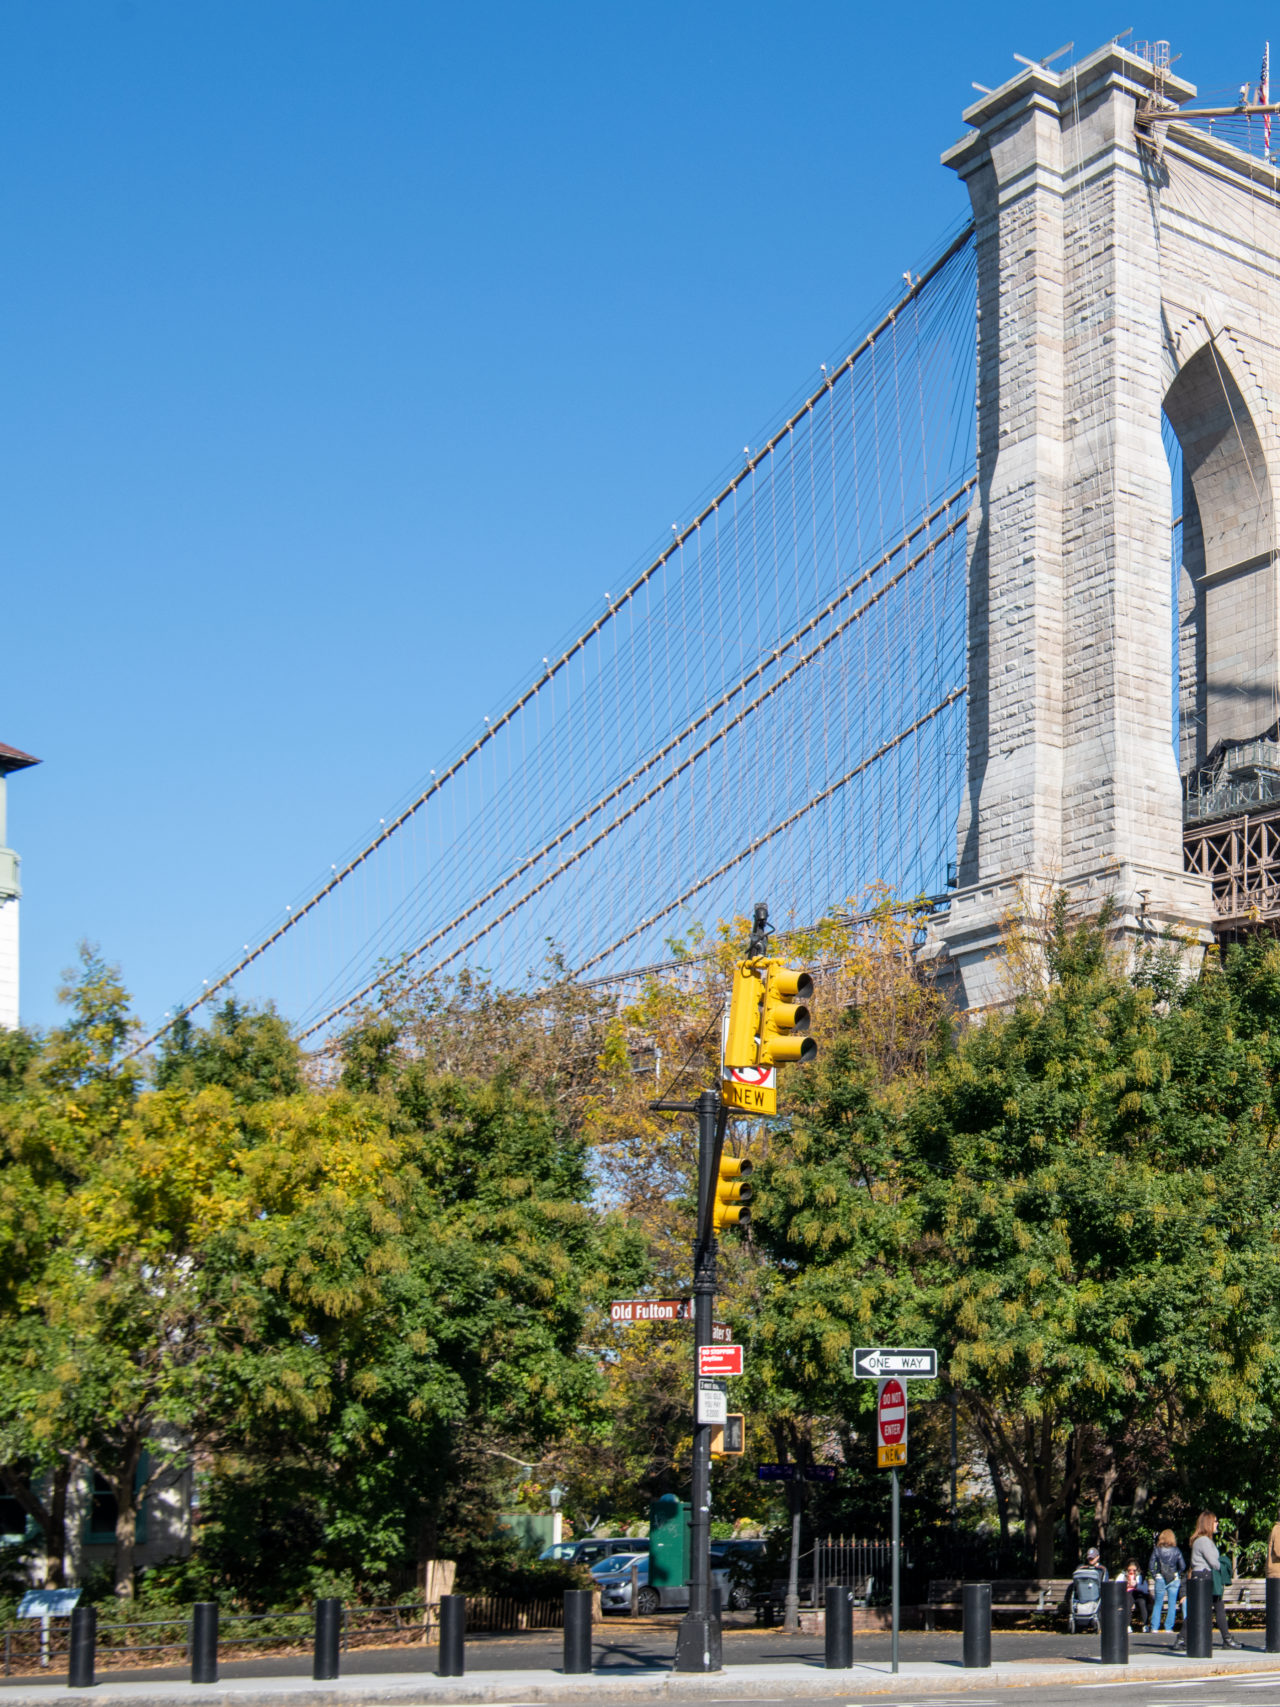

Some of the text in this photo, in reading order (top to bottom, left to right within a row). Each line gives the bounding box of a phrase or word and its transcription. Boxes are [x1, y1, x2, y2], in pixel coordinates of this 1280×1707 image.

[734, 1088, 764, 1106] NEW
[612, 1304, 689, 1319] Old Fulton St
[712, 1325, 732, 1342] ater St
[869, 1357, 923, 1368] ONE WAY
[883, 1392, 902, 1405] DO NOT
[884, 1424, 901, 1436] ENTER
[885, 1448, 900, 1462] NEW
